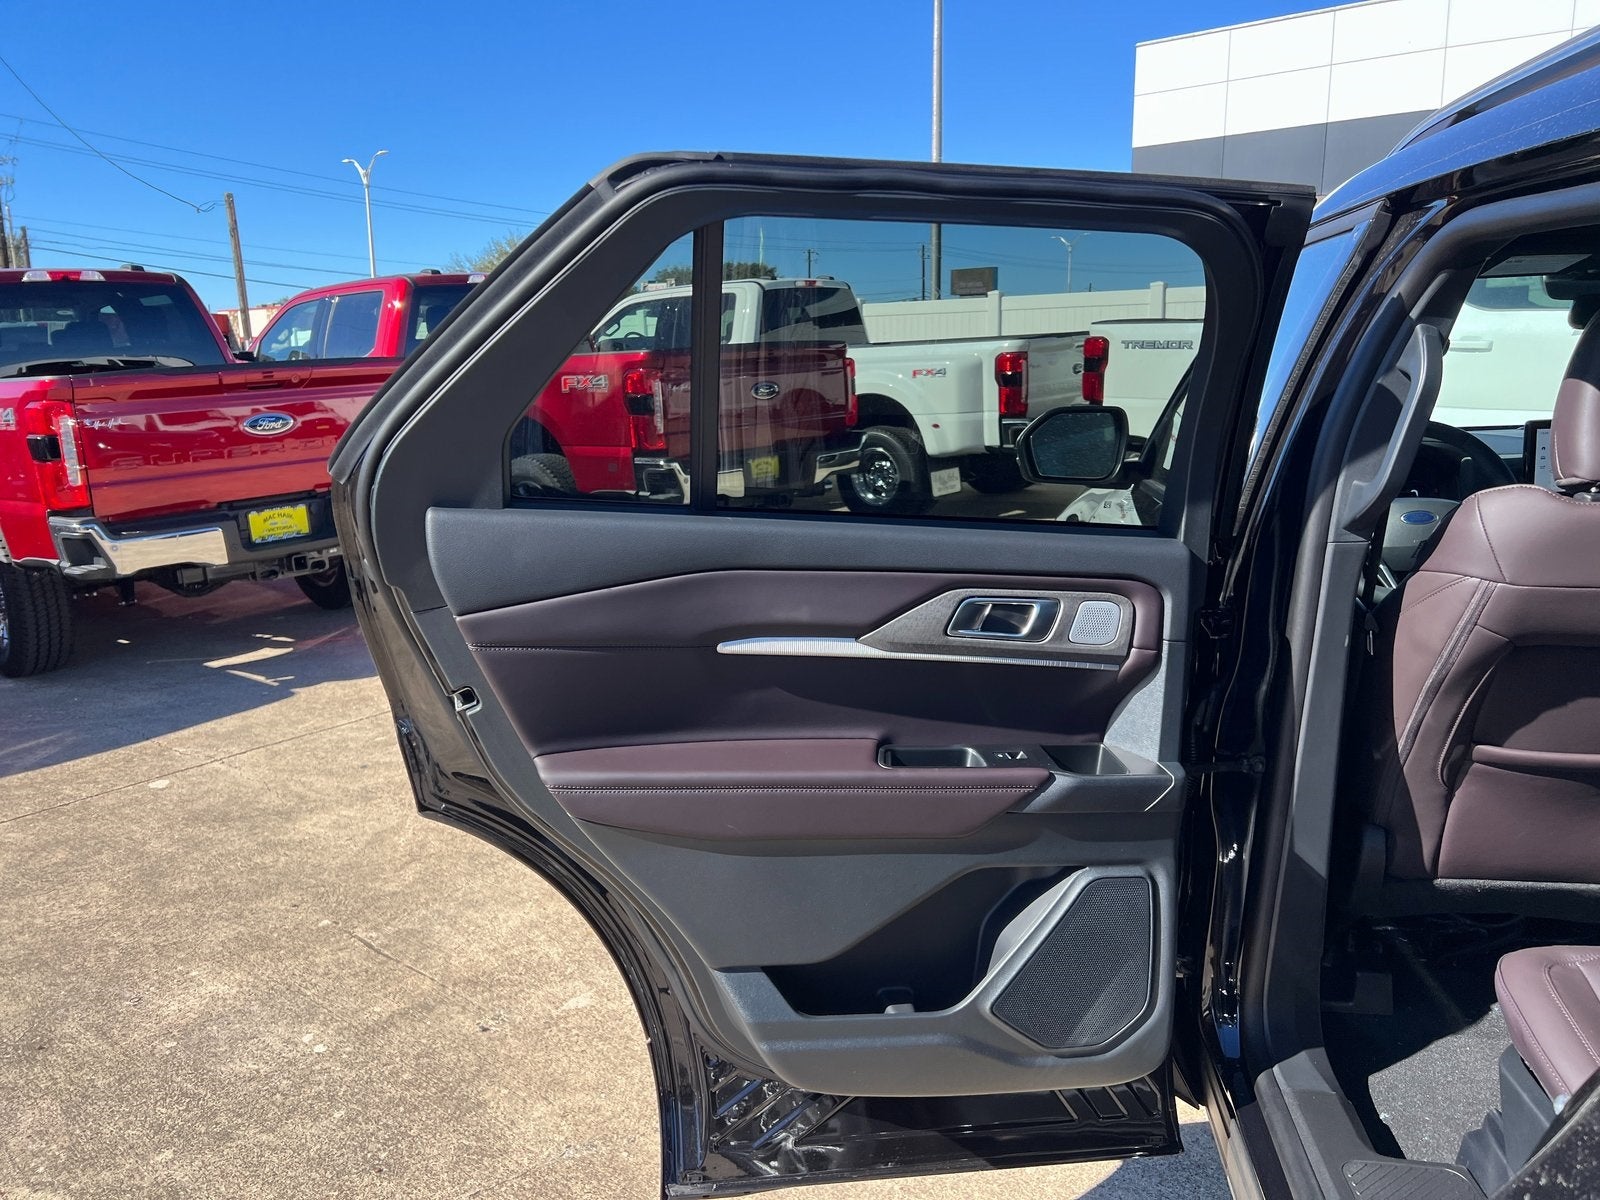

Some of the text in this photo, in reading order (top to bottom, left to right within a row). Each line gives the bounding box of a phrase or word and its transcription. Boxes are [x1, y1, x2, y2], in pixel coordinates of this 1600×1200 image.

[1120, 339, 1194, 350] TREMOR
[912, 367, 947, 379] FX4
[561, 374, 608, 393] FX4
[256, 417, 283, 430] Ford
